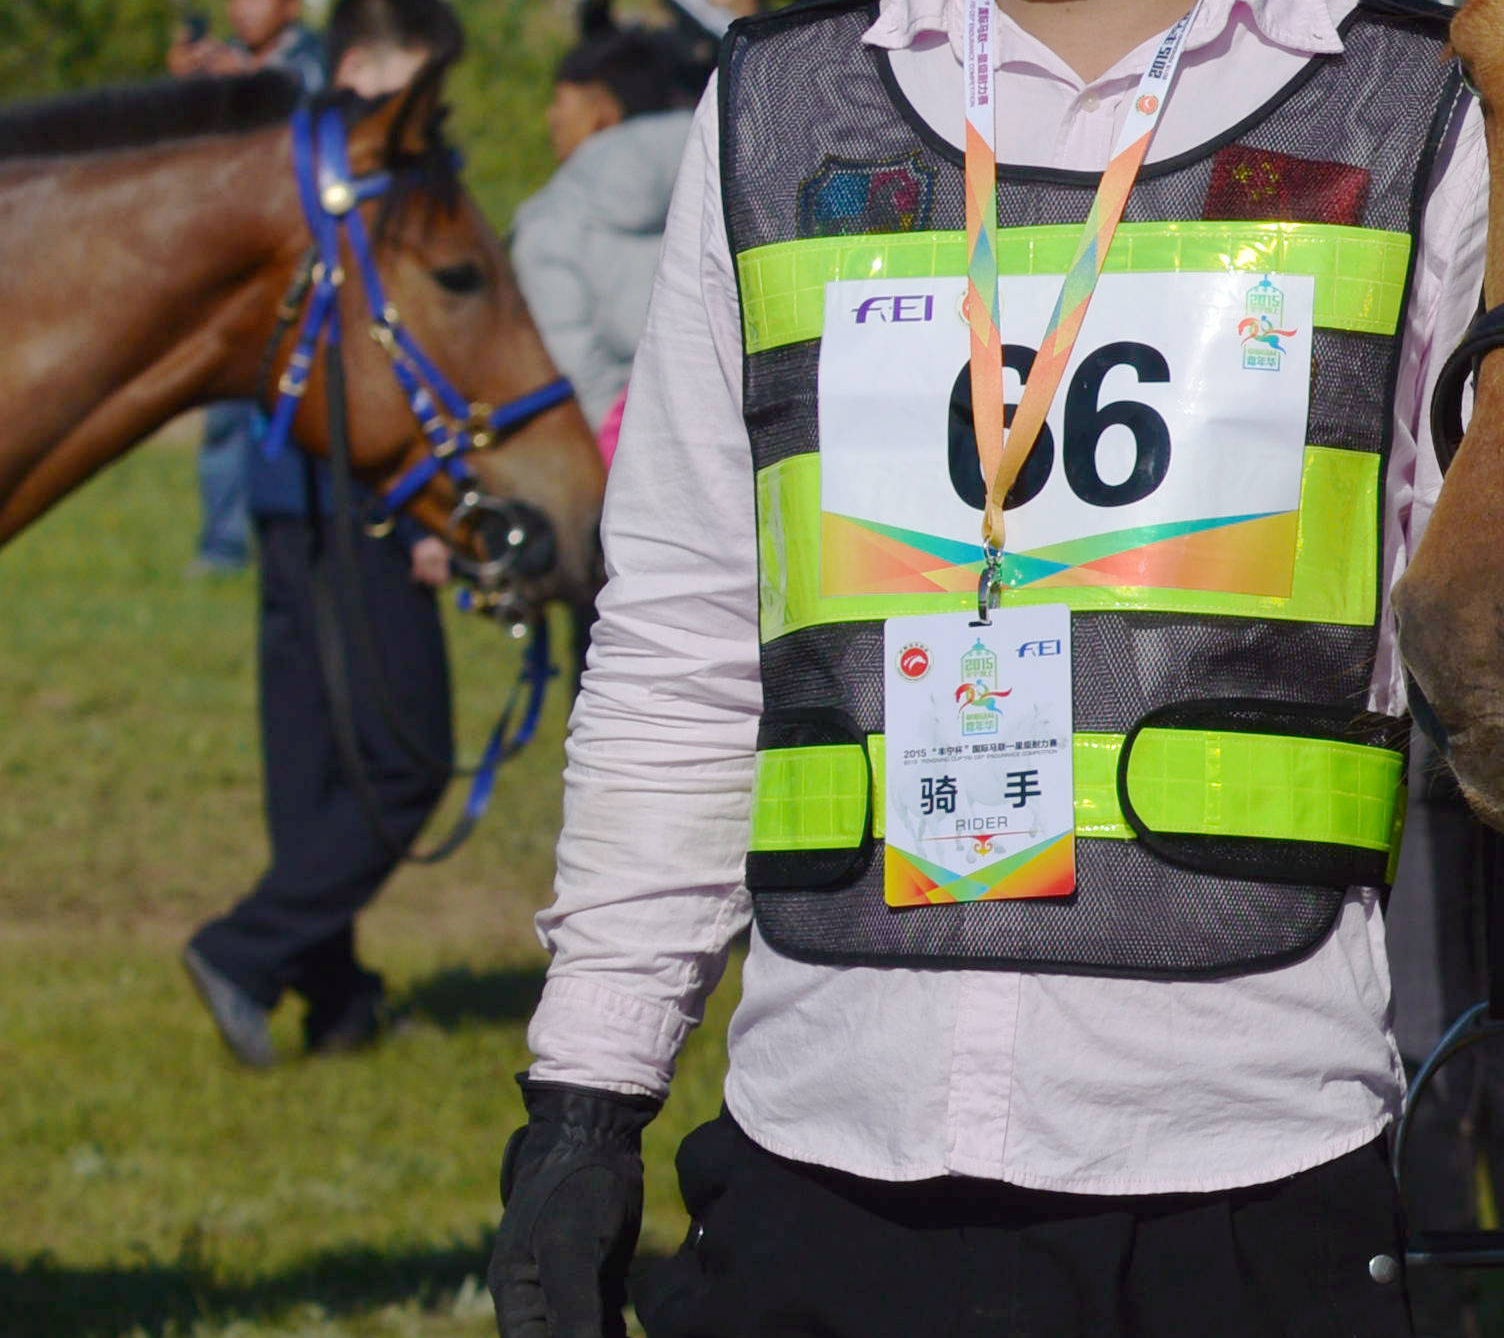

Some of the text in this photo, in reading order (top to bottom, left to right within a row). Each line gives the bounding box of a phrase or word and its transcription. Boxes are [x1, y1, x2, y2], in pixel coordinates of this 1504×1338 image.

[851, 295, 933, 324] FEI
[947, 340, 1172, 511] 66
[1016, 639, 1061, 658] FEI
[964, 657, 993, 672] 2015
[903, 748, 927, 759] 2015
[920, 769, 1042, 815] 骑 手
[955, 816, 1008, 832] RIDER
